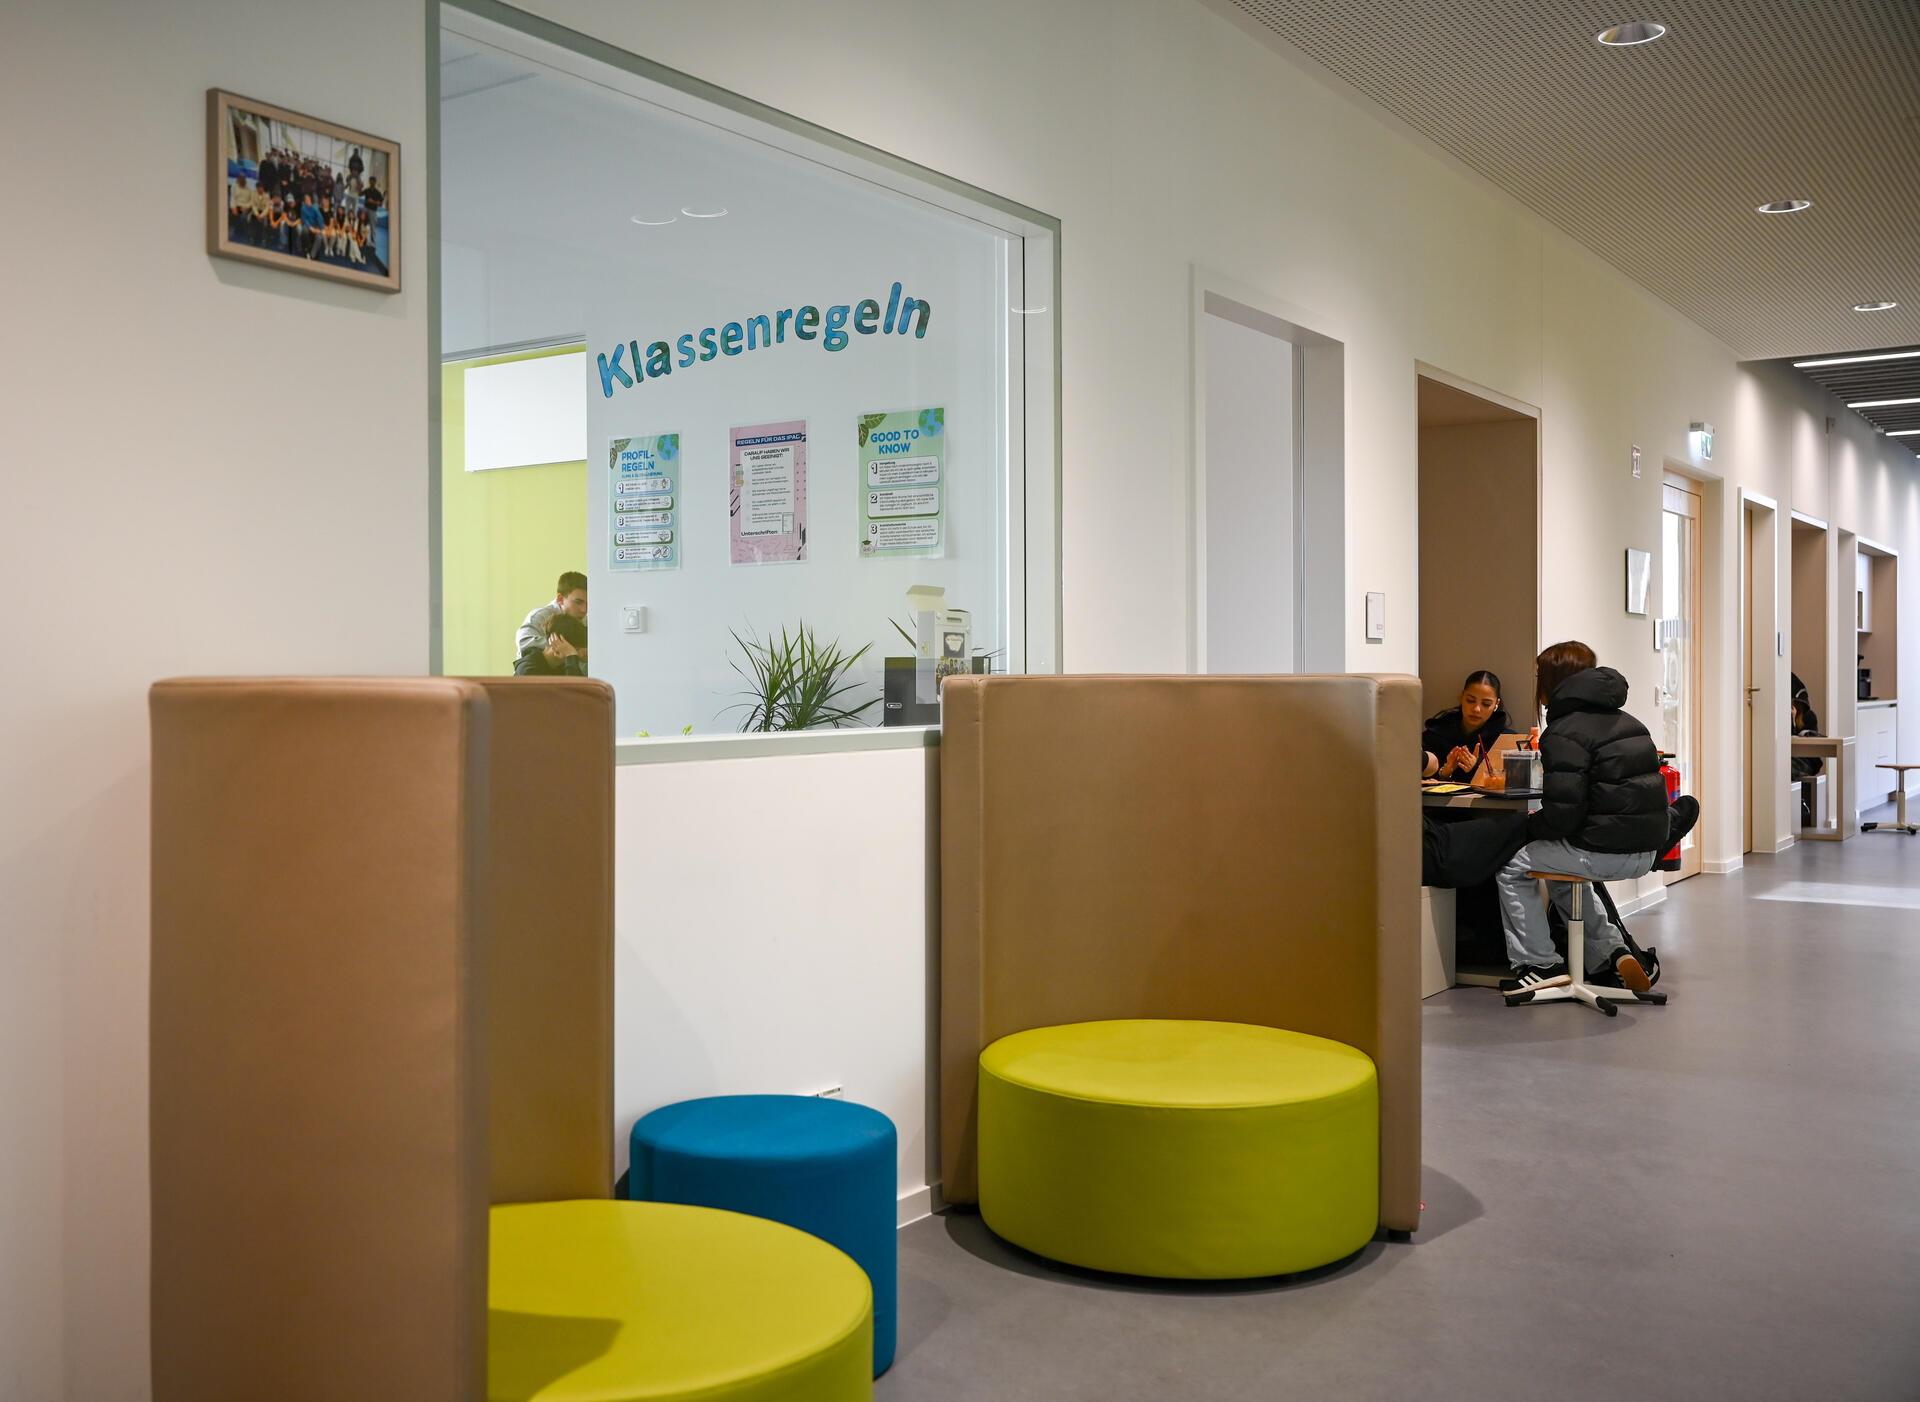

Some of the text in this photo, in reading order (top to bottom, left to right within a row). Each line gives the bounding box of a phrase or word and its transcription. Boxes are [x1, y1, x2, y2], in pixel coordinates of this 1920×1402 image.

[597, 281, 931, 398] Klassenregeln
[736, 438, 760, 446] REGELN
[761, 435, 773, 443] FÜR
[773, 434, 786, 442] DAS
[870, 429, 920, 443] GOOD TO
[878, 442, 911, 455] KNOW
[621, 450, 655, 461] PROFIL-
[621, 461, 655, 472] REGELN
[871, 462, 878, 475] 1
[618, 482, 624, 494] 1
[870, 493, 878, 504] 2
[618, 501, 625, 511] 2
[618, 515, 625, 526] 3
[740, 529, 778, 537] Unterschriften
[870, 523, 878, 535] 3
[618, 533, 625, 543] 4
[618, 549, 625, 560] 5
